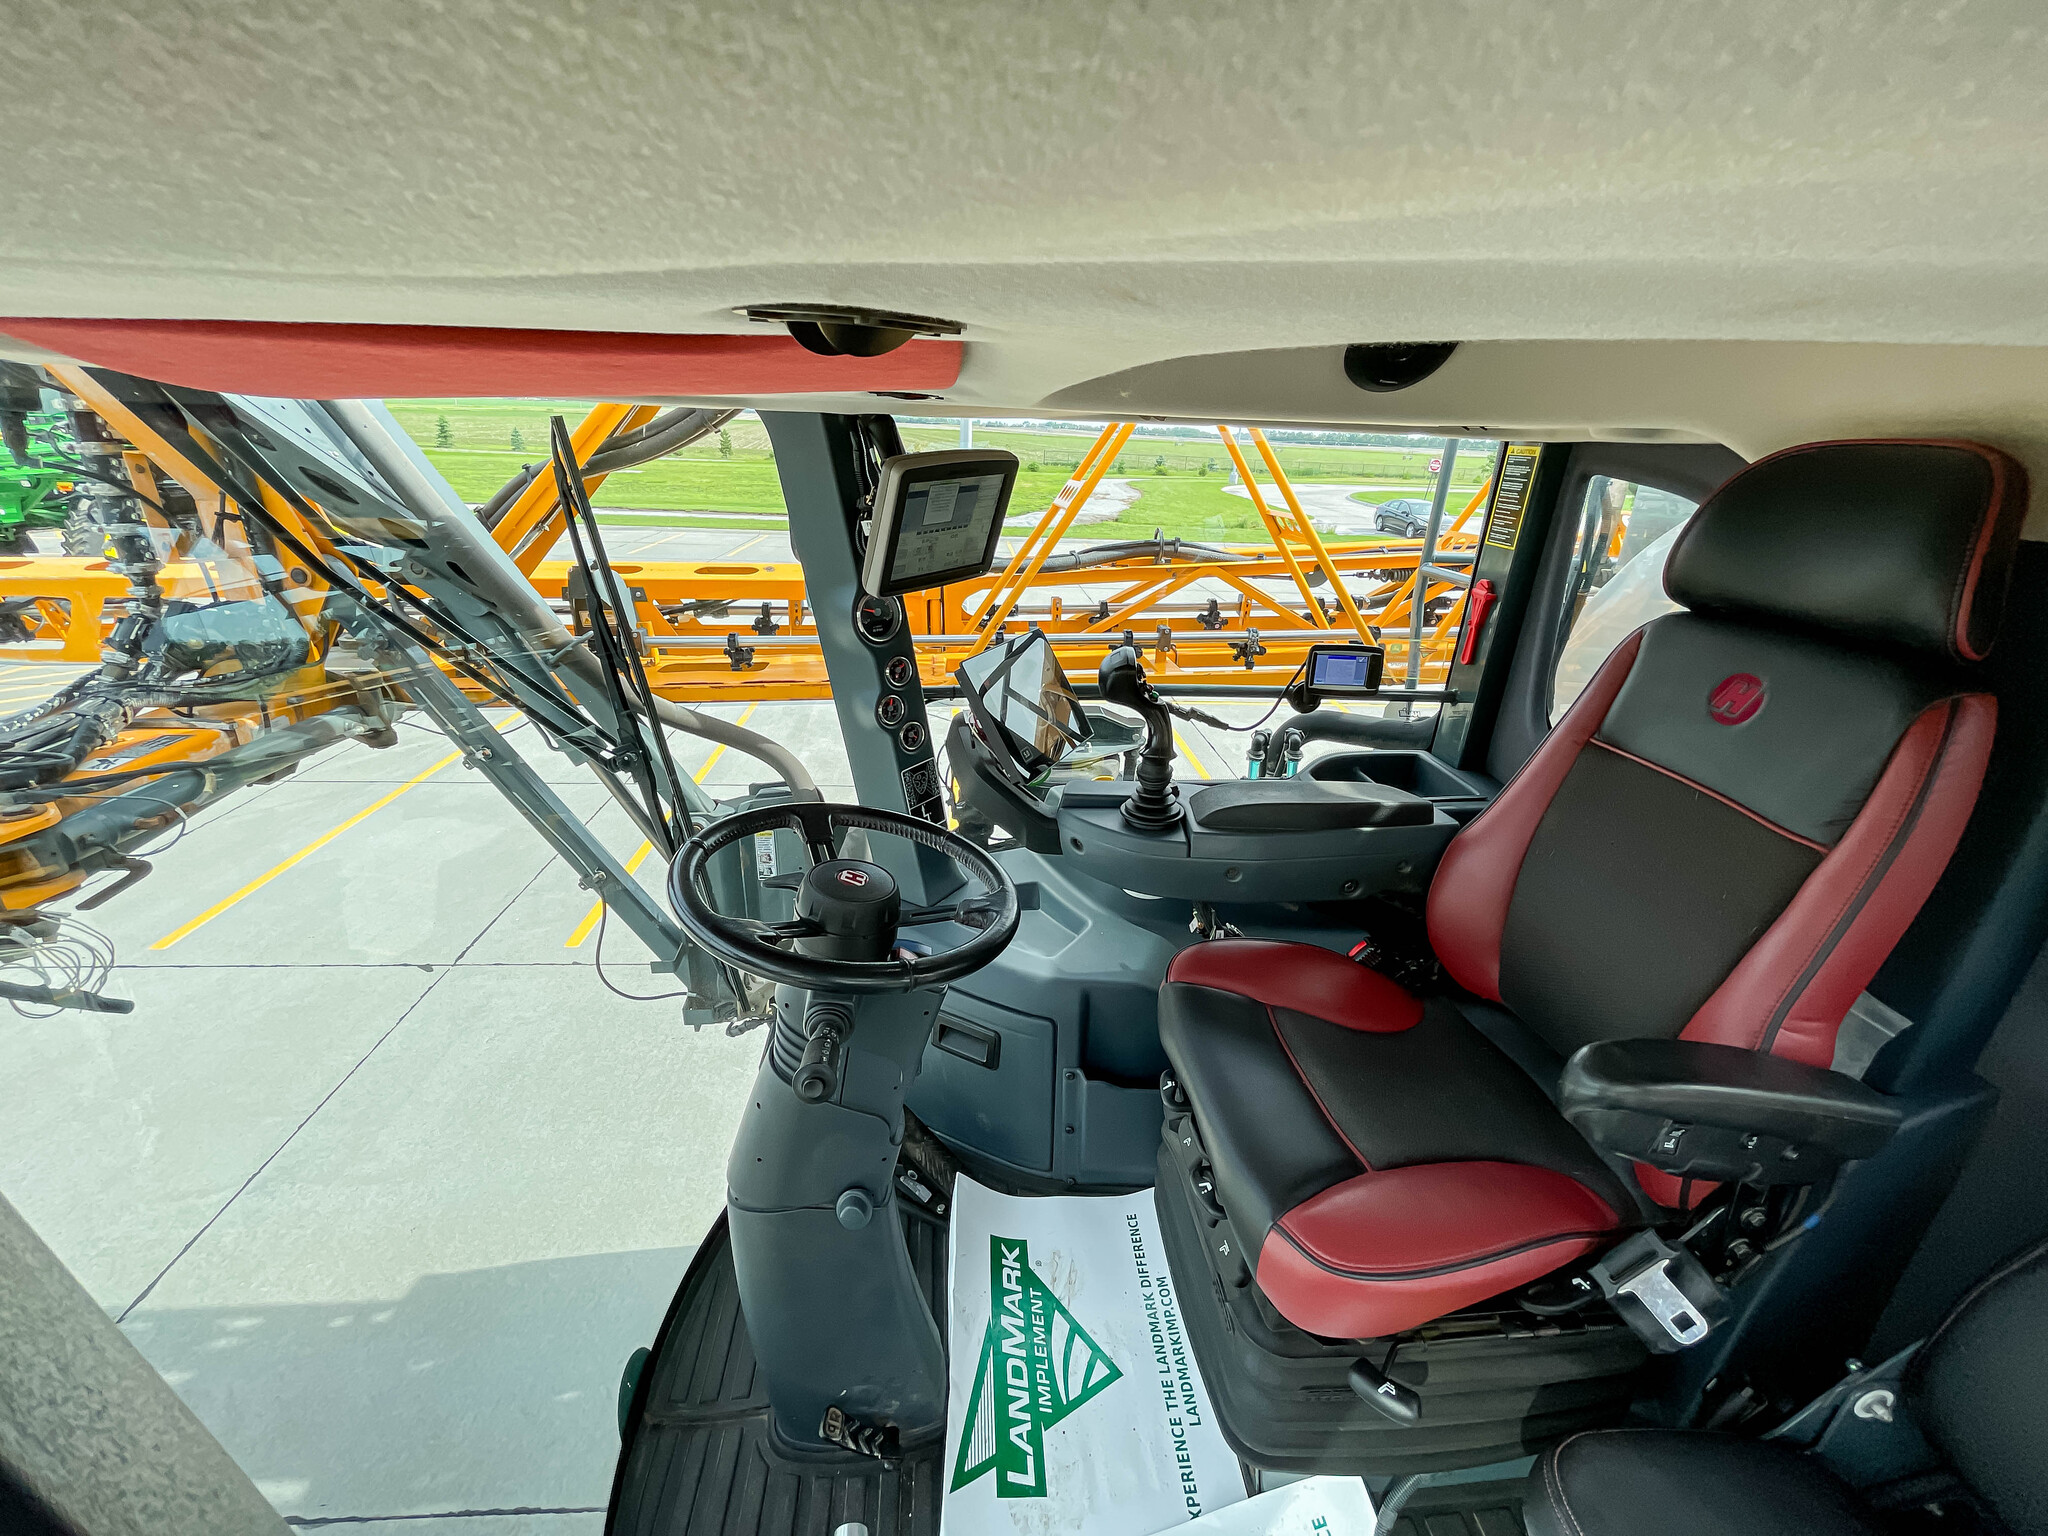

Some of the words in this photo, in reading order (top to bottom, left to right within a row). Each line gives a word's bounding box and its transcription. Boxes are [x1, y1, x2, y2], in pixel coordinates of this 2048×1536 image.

[1126, 1213, 1152, 1288] DIFFERENCE
[1000, 1242, 1036, 1487] LANDMARK
[1028, 1287, 1054, 1413] IMPLEMENT
[1143, 1291, 1171, 1374] LANDMARK
[1156, 1276, 1202, 1427] LANDMARKIMP.COM
[1161, 1379, 1179, 1412] THE
[1169, 1416, 1202, 1520] XPERIENCE
